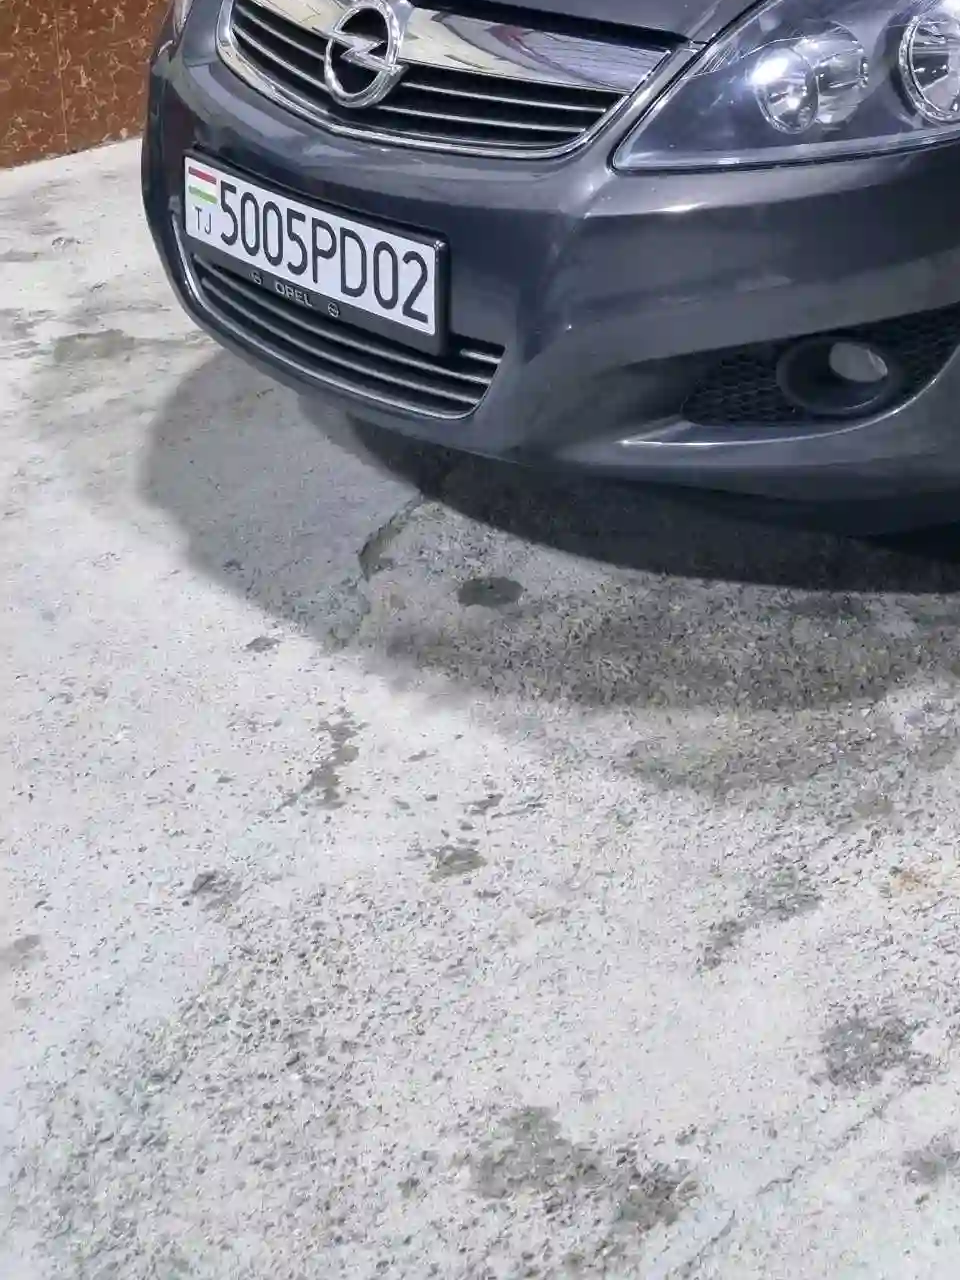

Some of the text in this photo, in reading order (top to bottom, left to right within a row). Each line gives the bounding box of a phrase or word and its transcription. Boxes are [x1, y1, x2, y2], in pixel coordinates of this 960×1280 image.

[192, 206, 212, 235] TJ
[220, 179, 429, 324] 5005PD02
[275, 281, 313, 307] OPEL
